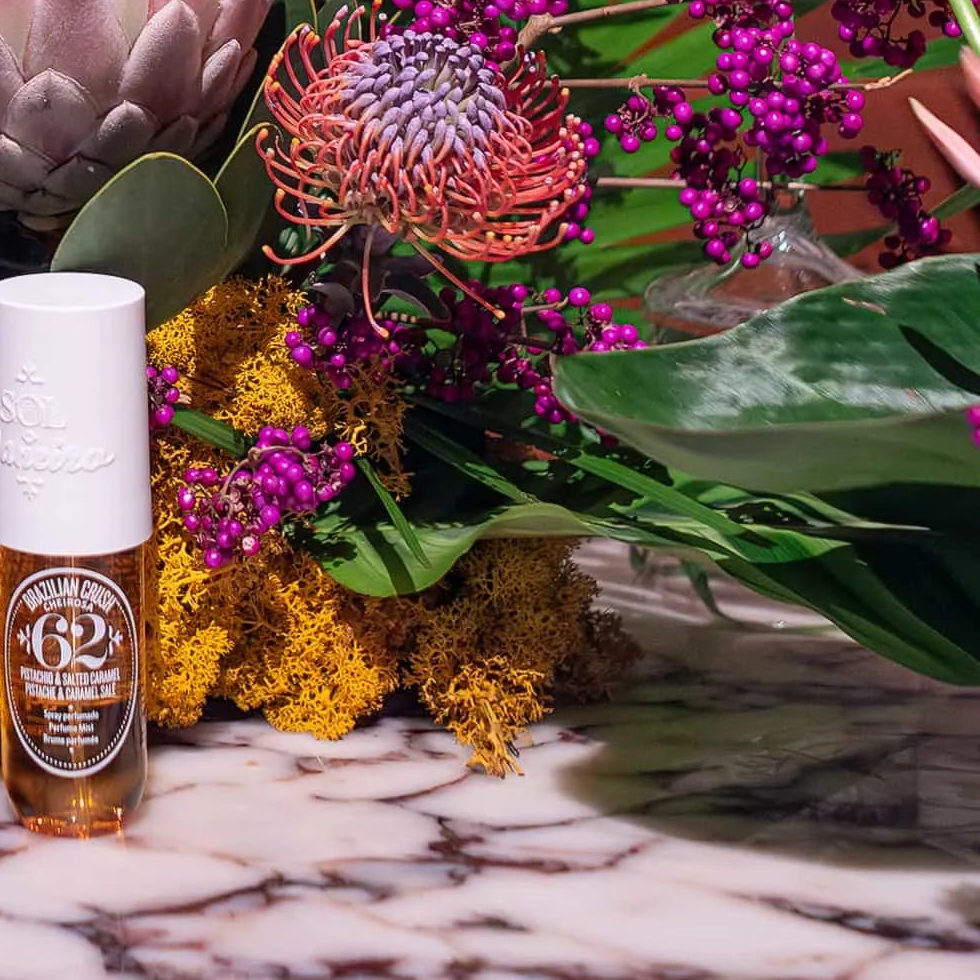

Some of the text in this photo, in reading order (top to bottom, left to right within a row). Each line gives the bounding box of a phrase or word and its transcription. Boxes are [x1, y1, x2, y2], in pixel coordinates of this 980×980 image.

[0, 389, 68, 430] SOL
[21, 577, 118, 615] BRAZILIAN CRUSH
[43, 597, 94, 613] CHEIROSA
[31, 612, 108, 670] 62
